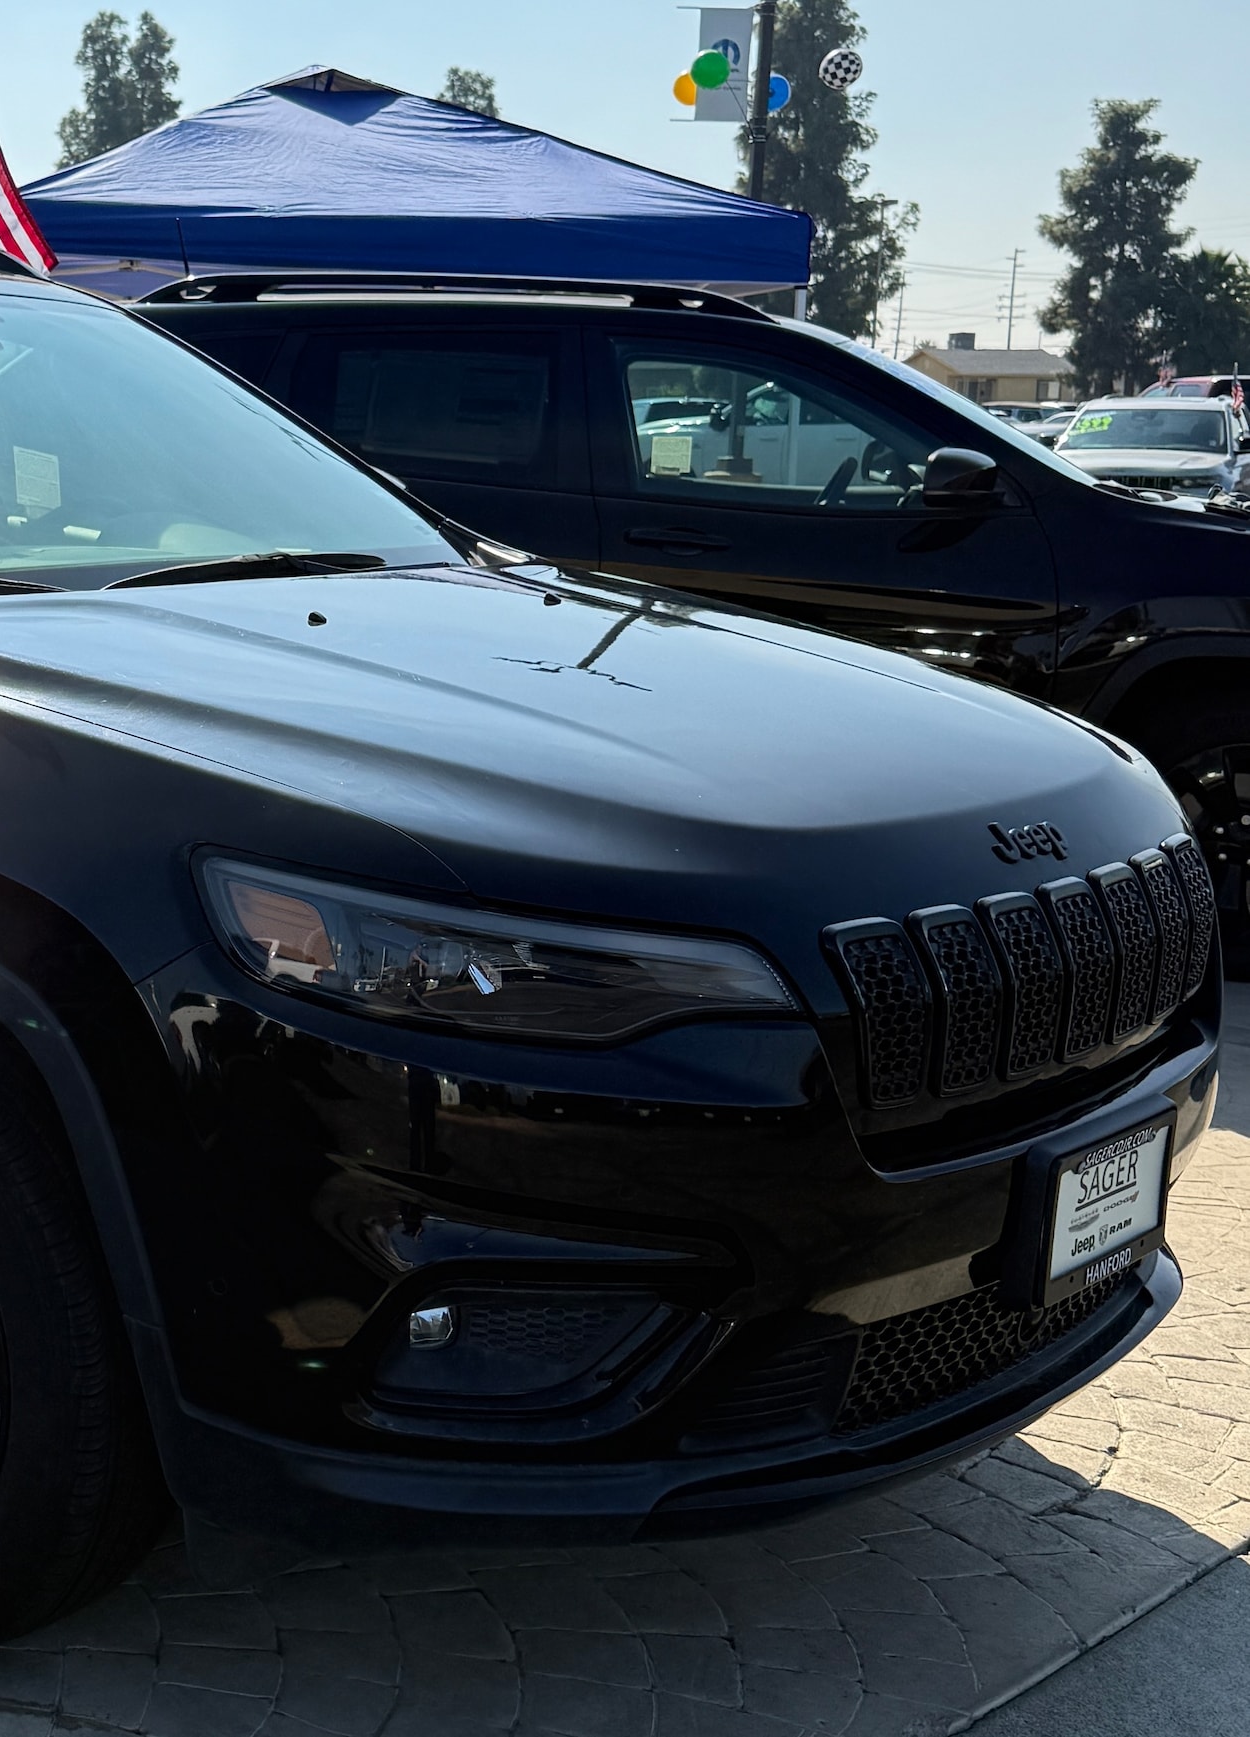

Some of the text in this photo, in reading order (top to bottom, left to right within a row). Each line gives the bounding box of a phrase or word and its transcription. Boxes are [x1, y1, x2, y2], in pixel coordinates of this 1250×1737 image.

[987, 821, 1068, 864] Jeep
[1077, 1149, 1139, 1204] SAGER
[1071, 1217, 1133, 1257] Jeep RAM
[1085, 1247, 1133, 1285] HANFORD
